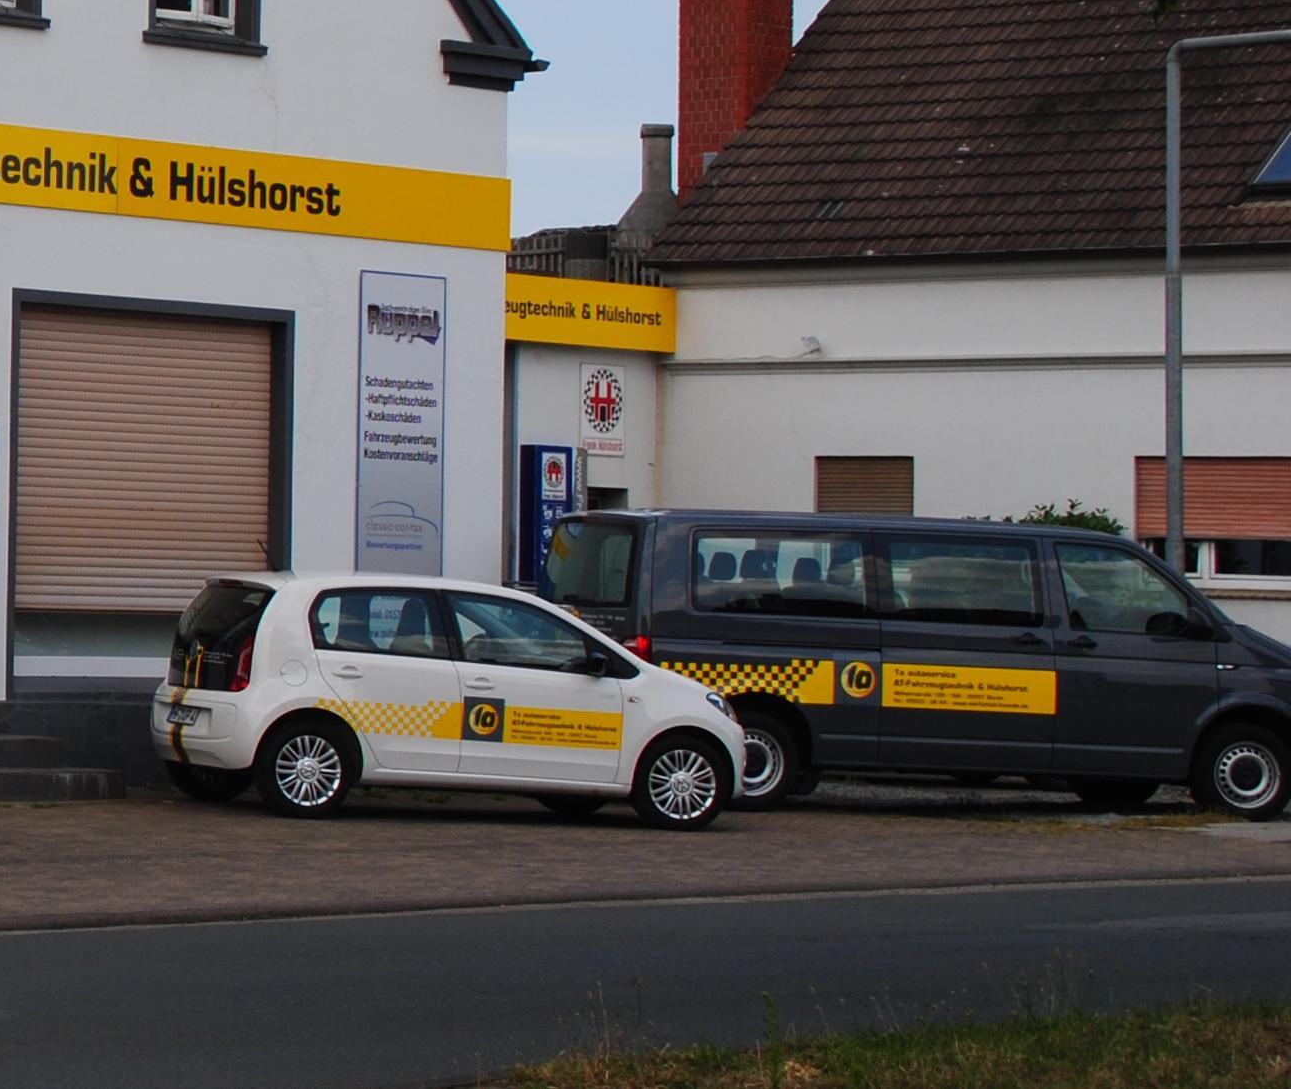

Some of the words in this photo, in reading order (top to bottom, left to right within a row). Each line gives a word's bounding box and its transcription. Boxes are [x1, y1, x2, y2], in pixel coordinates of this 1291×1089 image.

[129, 157, 155, 198] &
[170, 161, 341, 217] Hülshorst
[582, 303, 591, 320] &
[596, 304, 662, 326] Hülshorst
[365, 375, 434, 391] Schadengutachten
[364, 430, 437, 448] Fahrzeugbewertung
